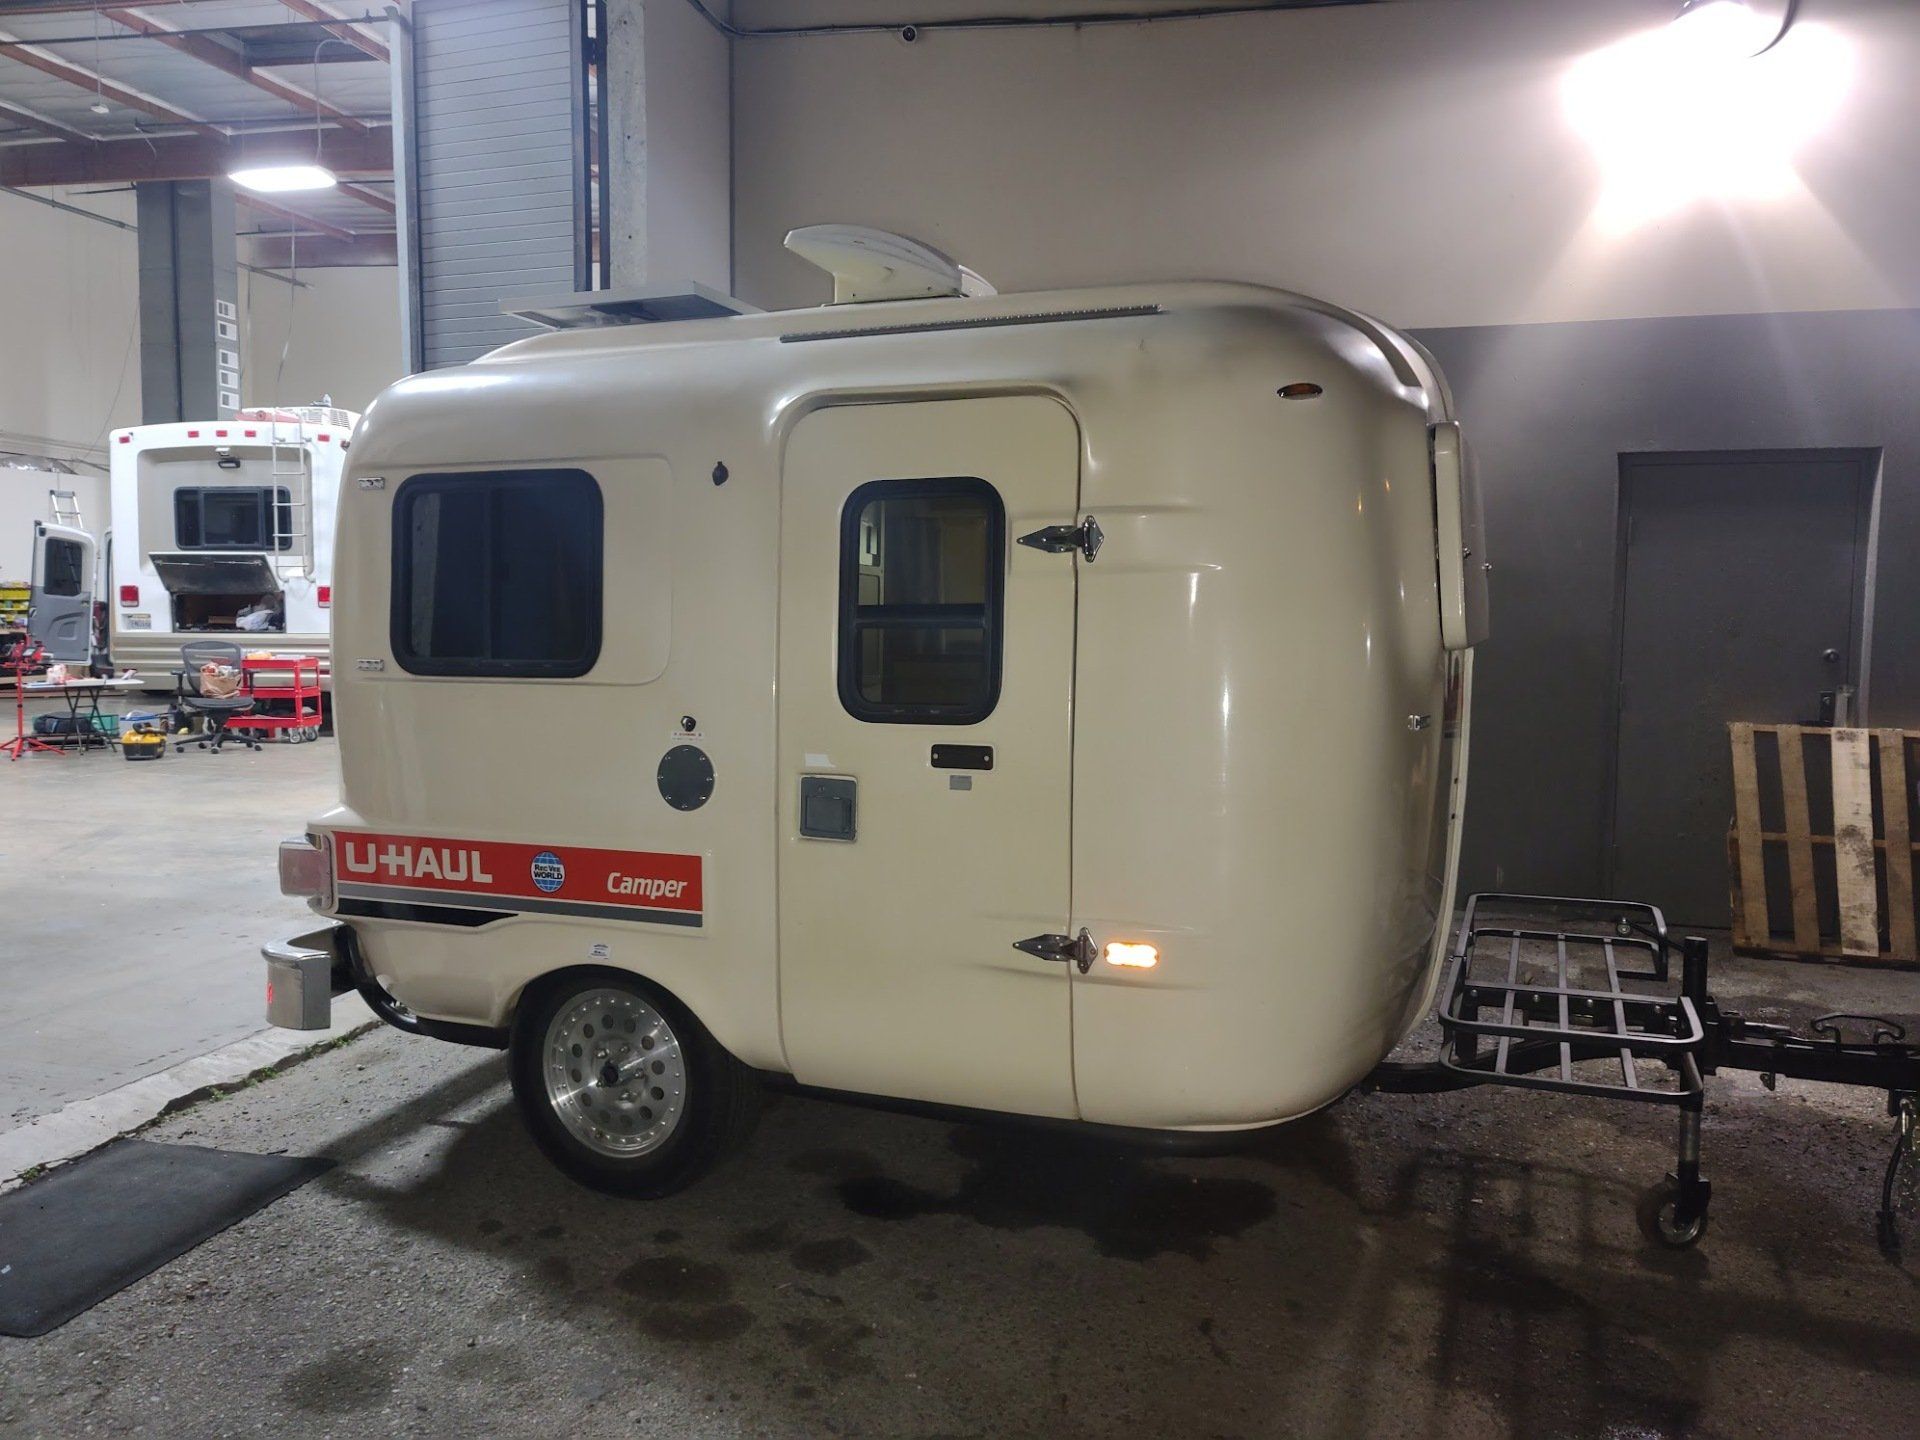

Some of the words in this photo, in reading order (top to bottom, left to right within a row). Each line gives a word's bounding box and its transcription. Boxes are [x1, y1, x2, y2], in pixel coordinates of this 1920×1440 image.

[345, 841, 493, 883] U-HAUL
[534, 870, 563, 879] WORLD
[607, 872, 688, 900] Camper
